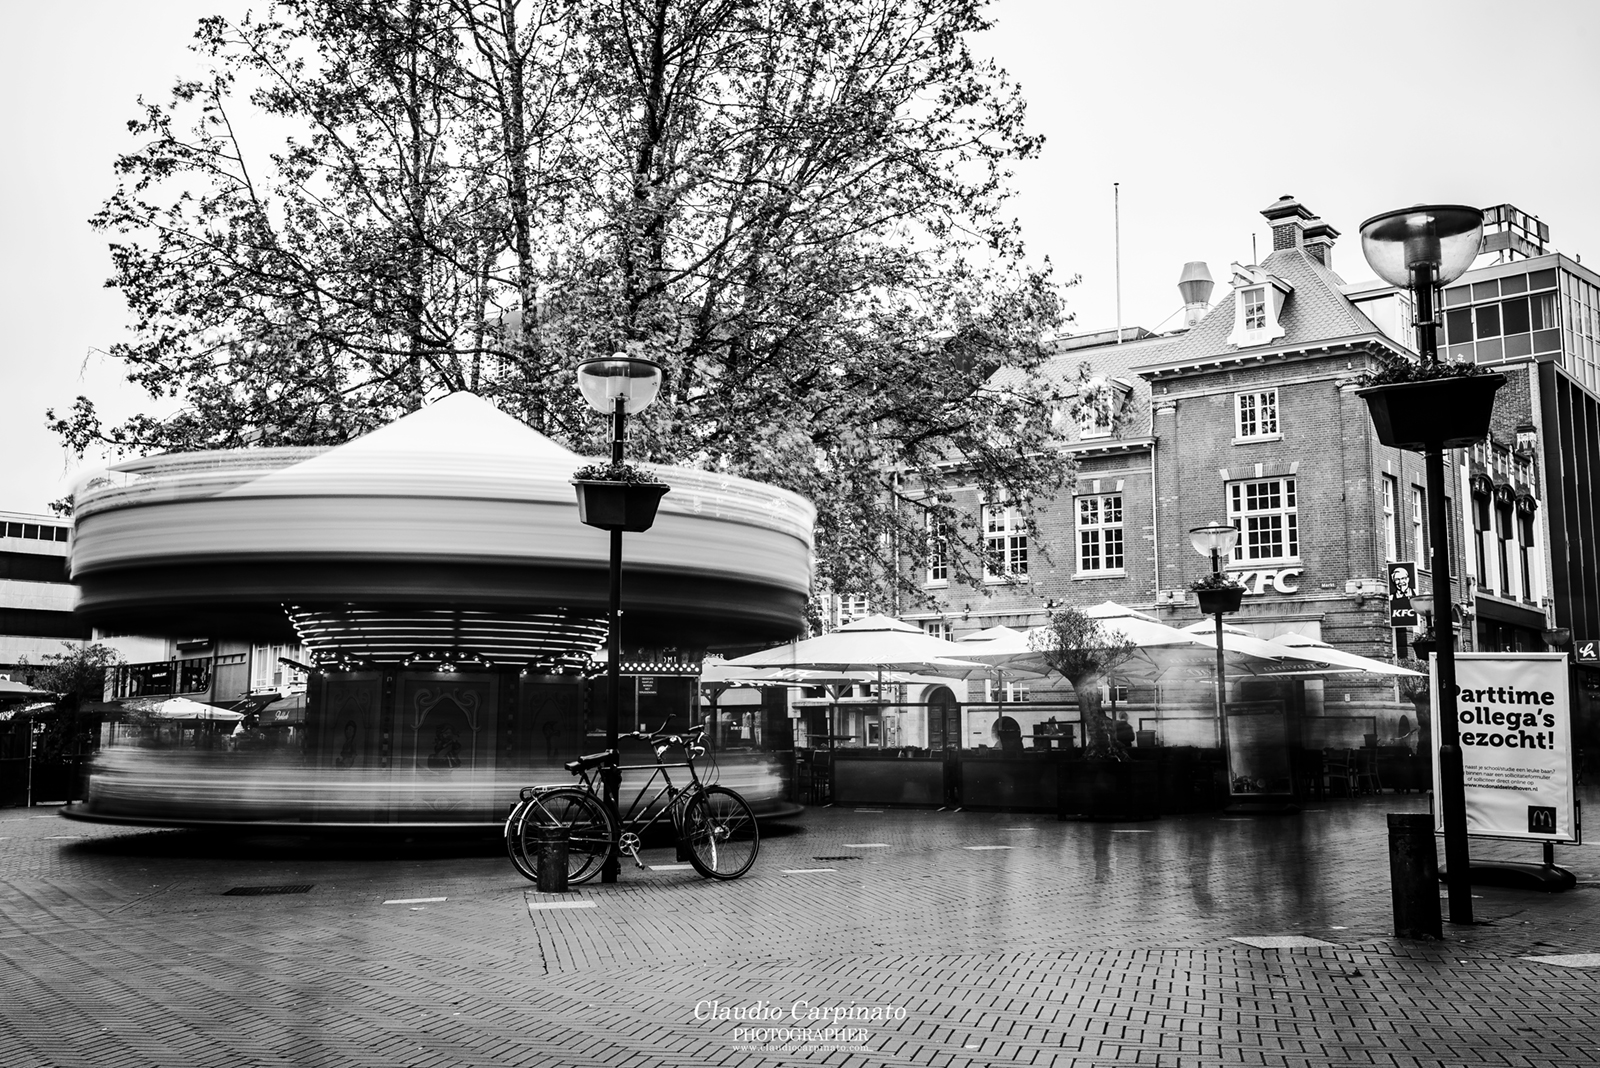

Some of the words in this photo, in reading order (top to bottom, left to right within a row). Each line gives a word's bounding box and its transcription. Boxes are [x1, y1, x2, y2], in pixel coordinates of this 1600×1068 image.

[1226, 568, 1304, 595] KFC
[1392, 608, 1415, 618] KFC
[1459, 706, 1555, 731] ollega's
[1459, 730, 1554, 750] ezocht!
